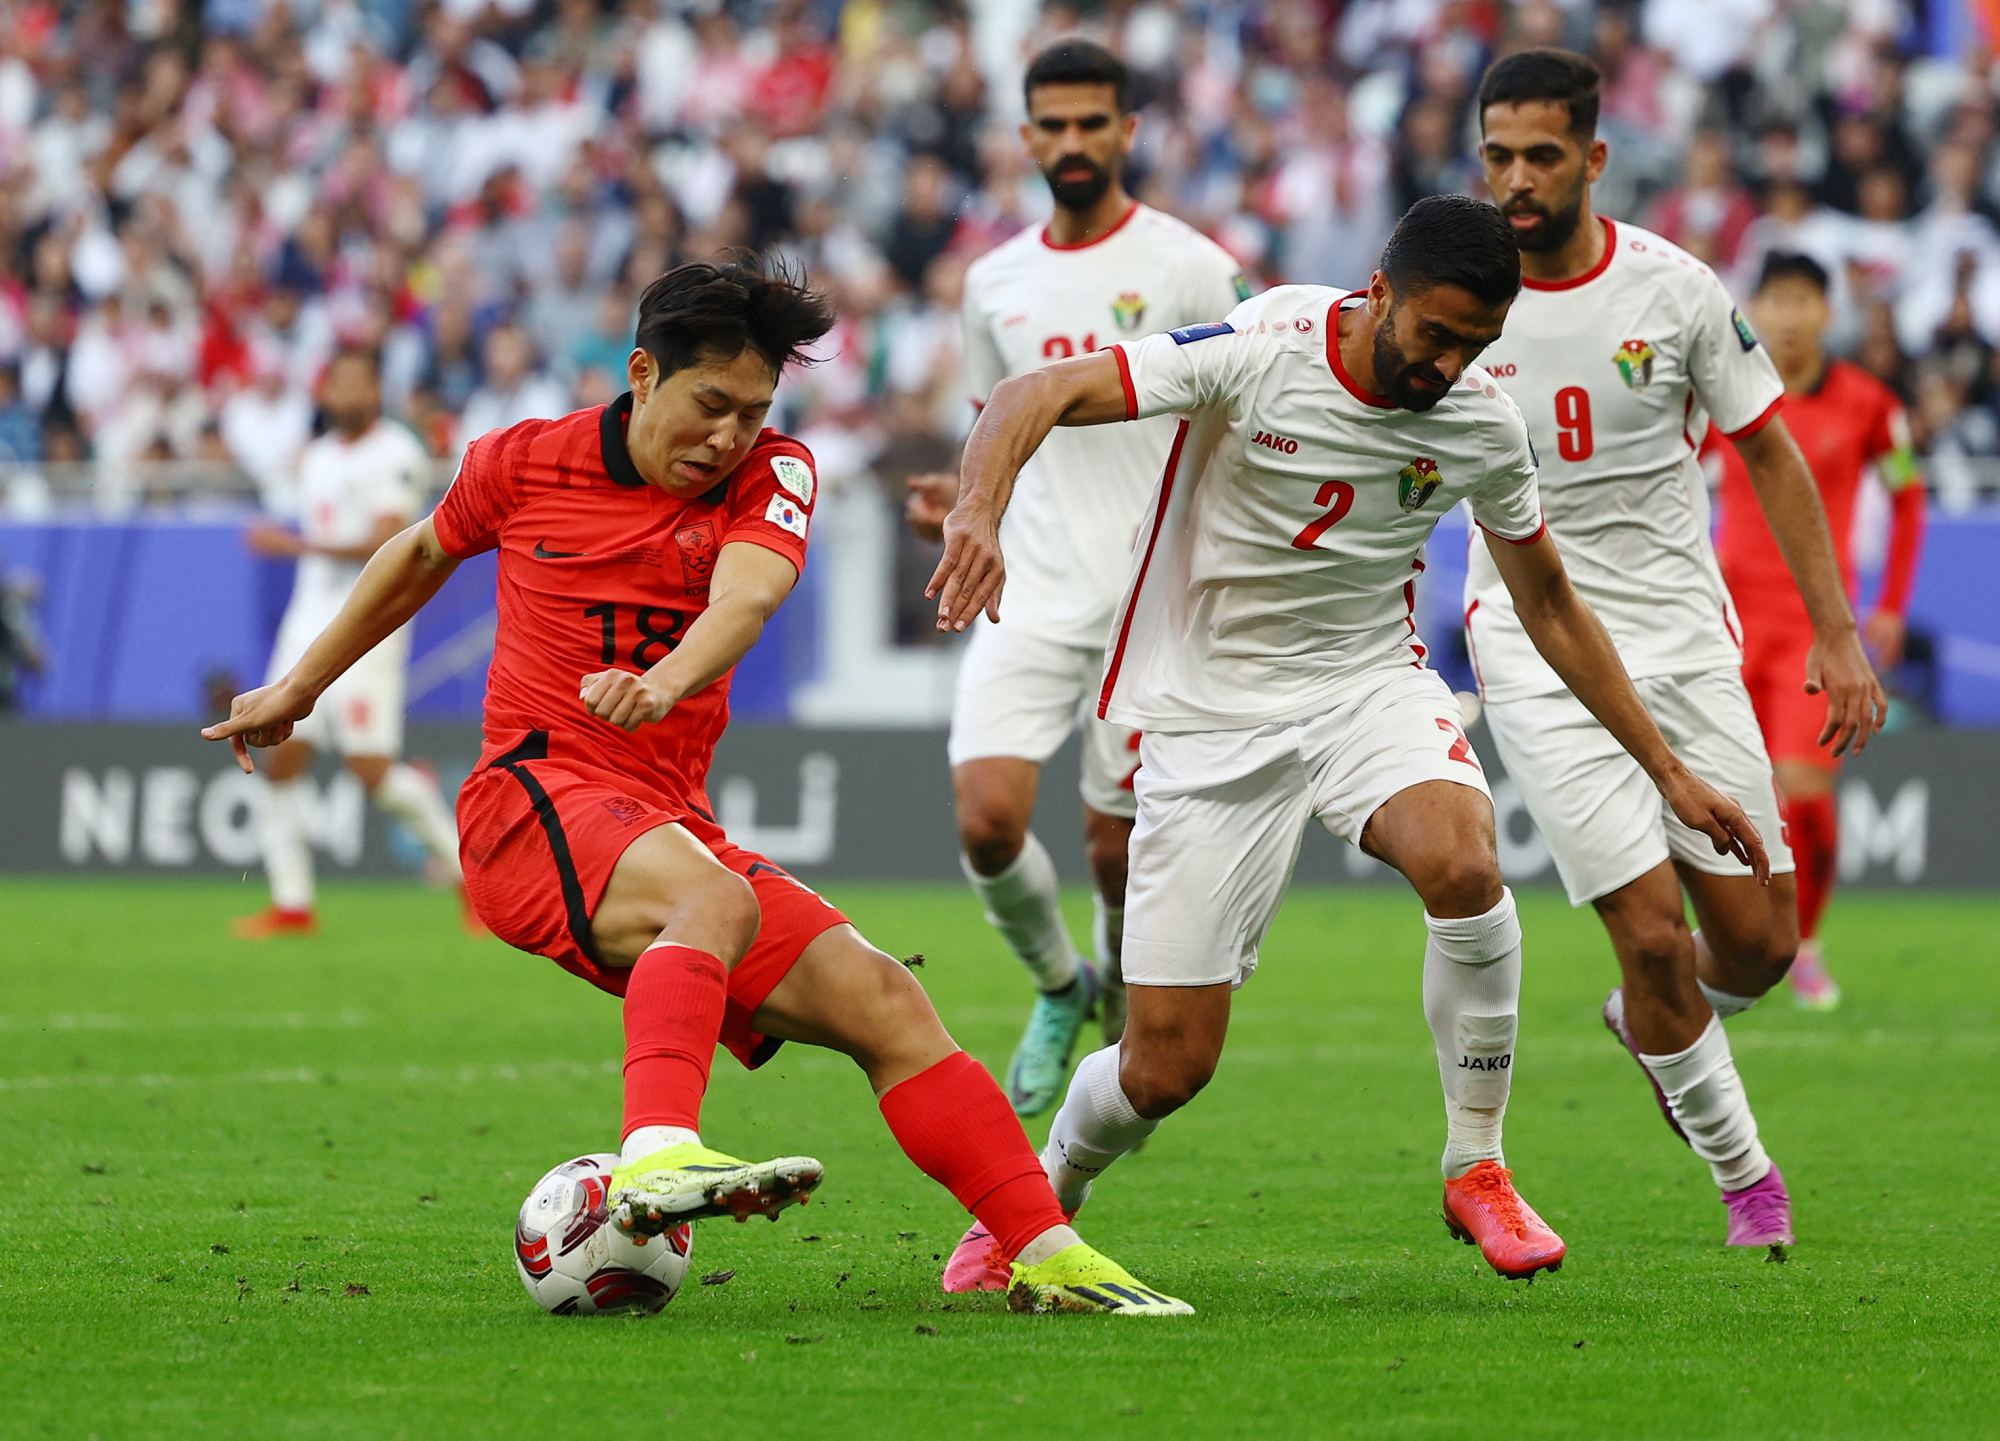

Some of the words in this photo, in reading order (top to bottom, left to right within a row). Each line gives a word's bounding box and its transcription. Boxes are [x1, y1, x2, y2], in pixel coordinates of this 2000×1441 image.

[1251, 430, 1298, 455] JAKO
[1555, 387, 1594, 462] 9
[779, 461, 798, 470] AFC
[1291, 480, 1355, 551] 2
[685, 586, 710, 598] KOR
[583, 603, 684, 672] 18
[1434, 717, 1482, 773] 2
[60, 765, 366, 867] NEOM
[1458, 1053, 1511, 1071] JAKO
